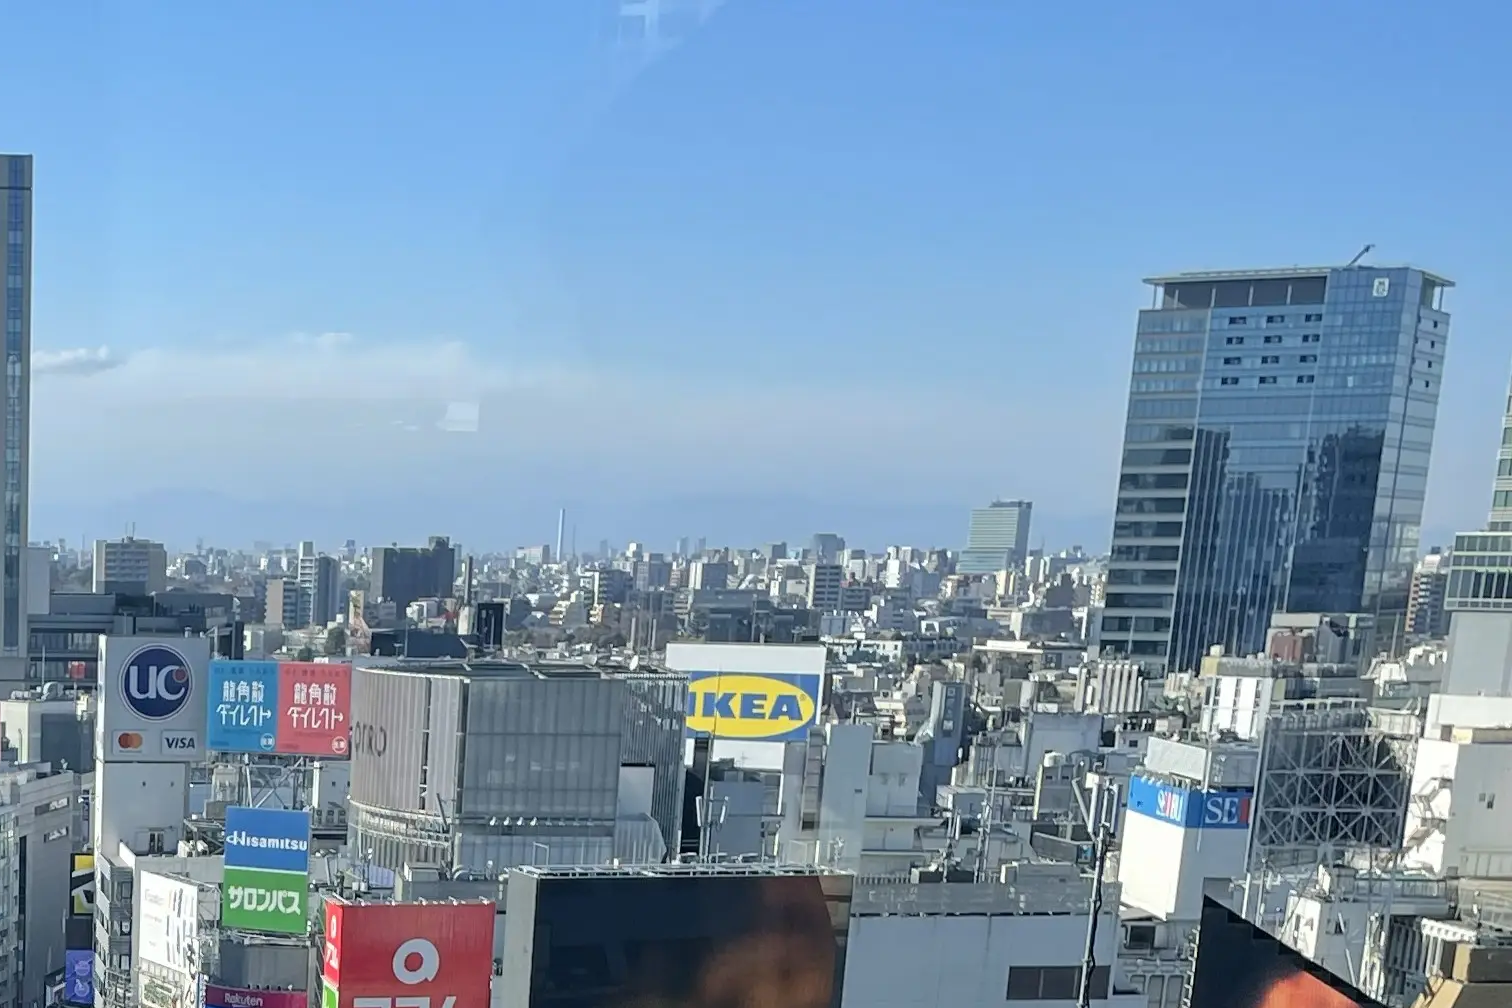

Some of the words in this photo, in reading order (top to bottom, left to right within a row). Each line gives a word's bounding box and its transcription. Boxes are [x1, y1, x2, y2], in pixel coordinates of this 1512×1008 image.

[223, 680, 265, 703] 龍角散
[294, 682, 337, 706] 龍角散
[688, 691, 803, 721] IKEA
[164, 737, 196, 749] VISA
[226, 830, 308, 851] Hisamitsu
[228, 885, 301, 916] サロンパス
[224, 992, 264, 1008] Rakuten
